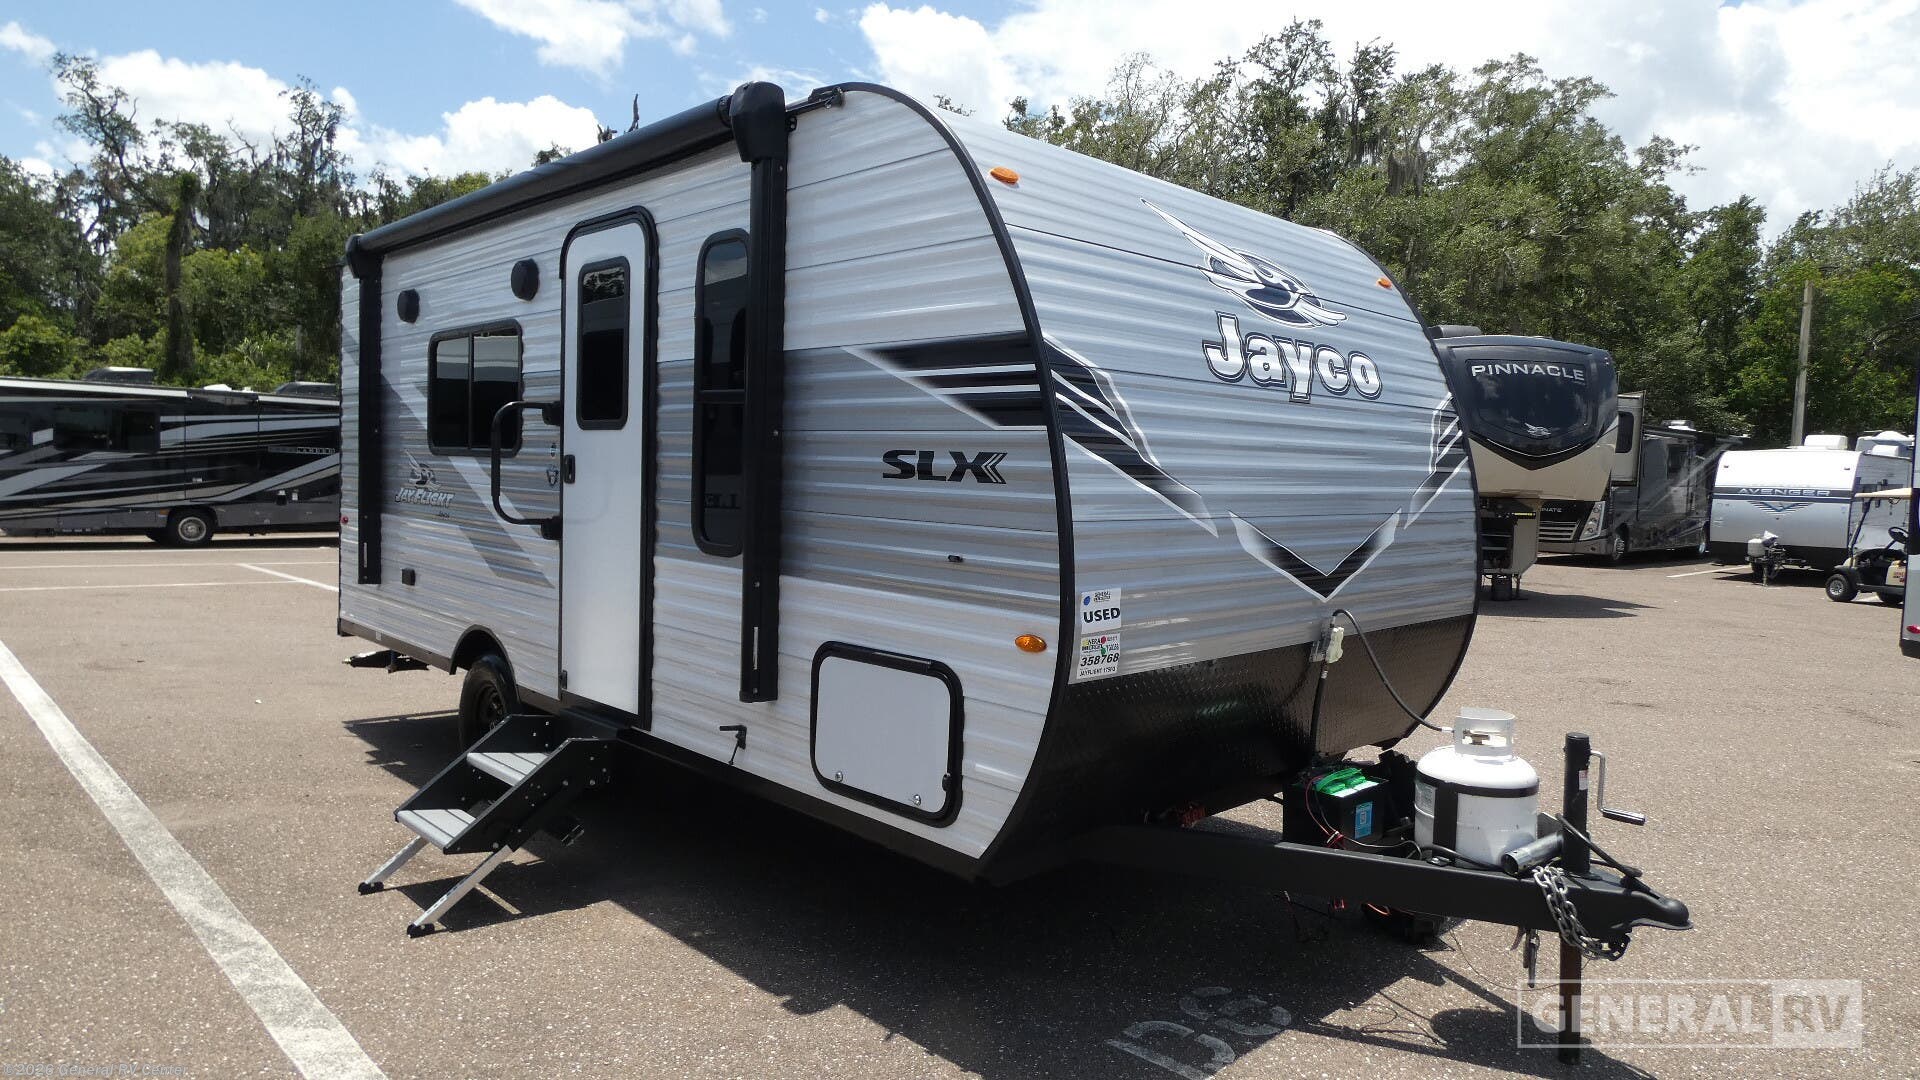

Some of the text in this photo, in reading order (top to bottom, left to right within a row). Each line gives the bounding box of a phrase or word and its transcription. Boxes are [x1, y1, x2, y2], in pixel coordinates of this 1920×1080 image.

[1202, 310, 1383, 404] Jayco
[1471, 363, 1585, 381] PINNACLE
[882, 449, 1007, 484] SLX
[1739, 488, 1831, 497] AVENGER
[1083, 607, 1121, 623] USED
[1080, 653, 1120, 667] 358768
